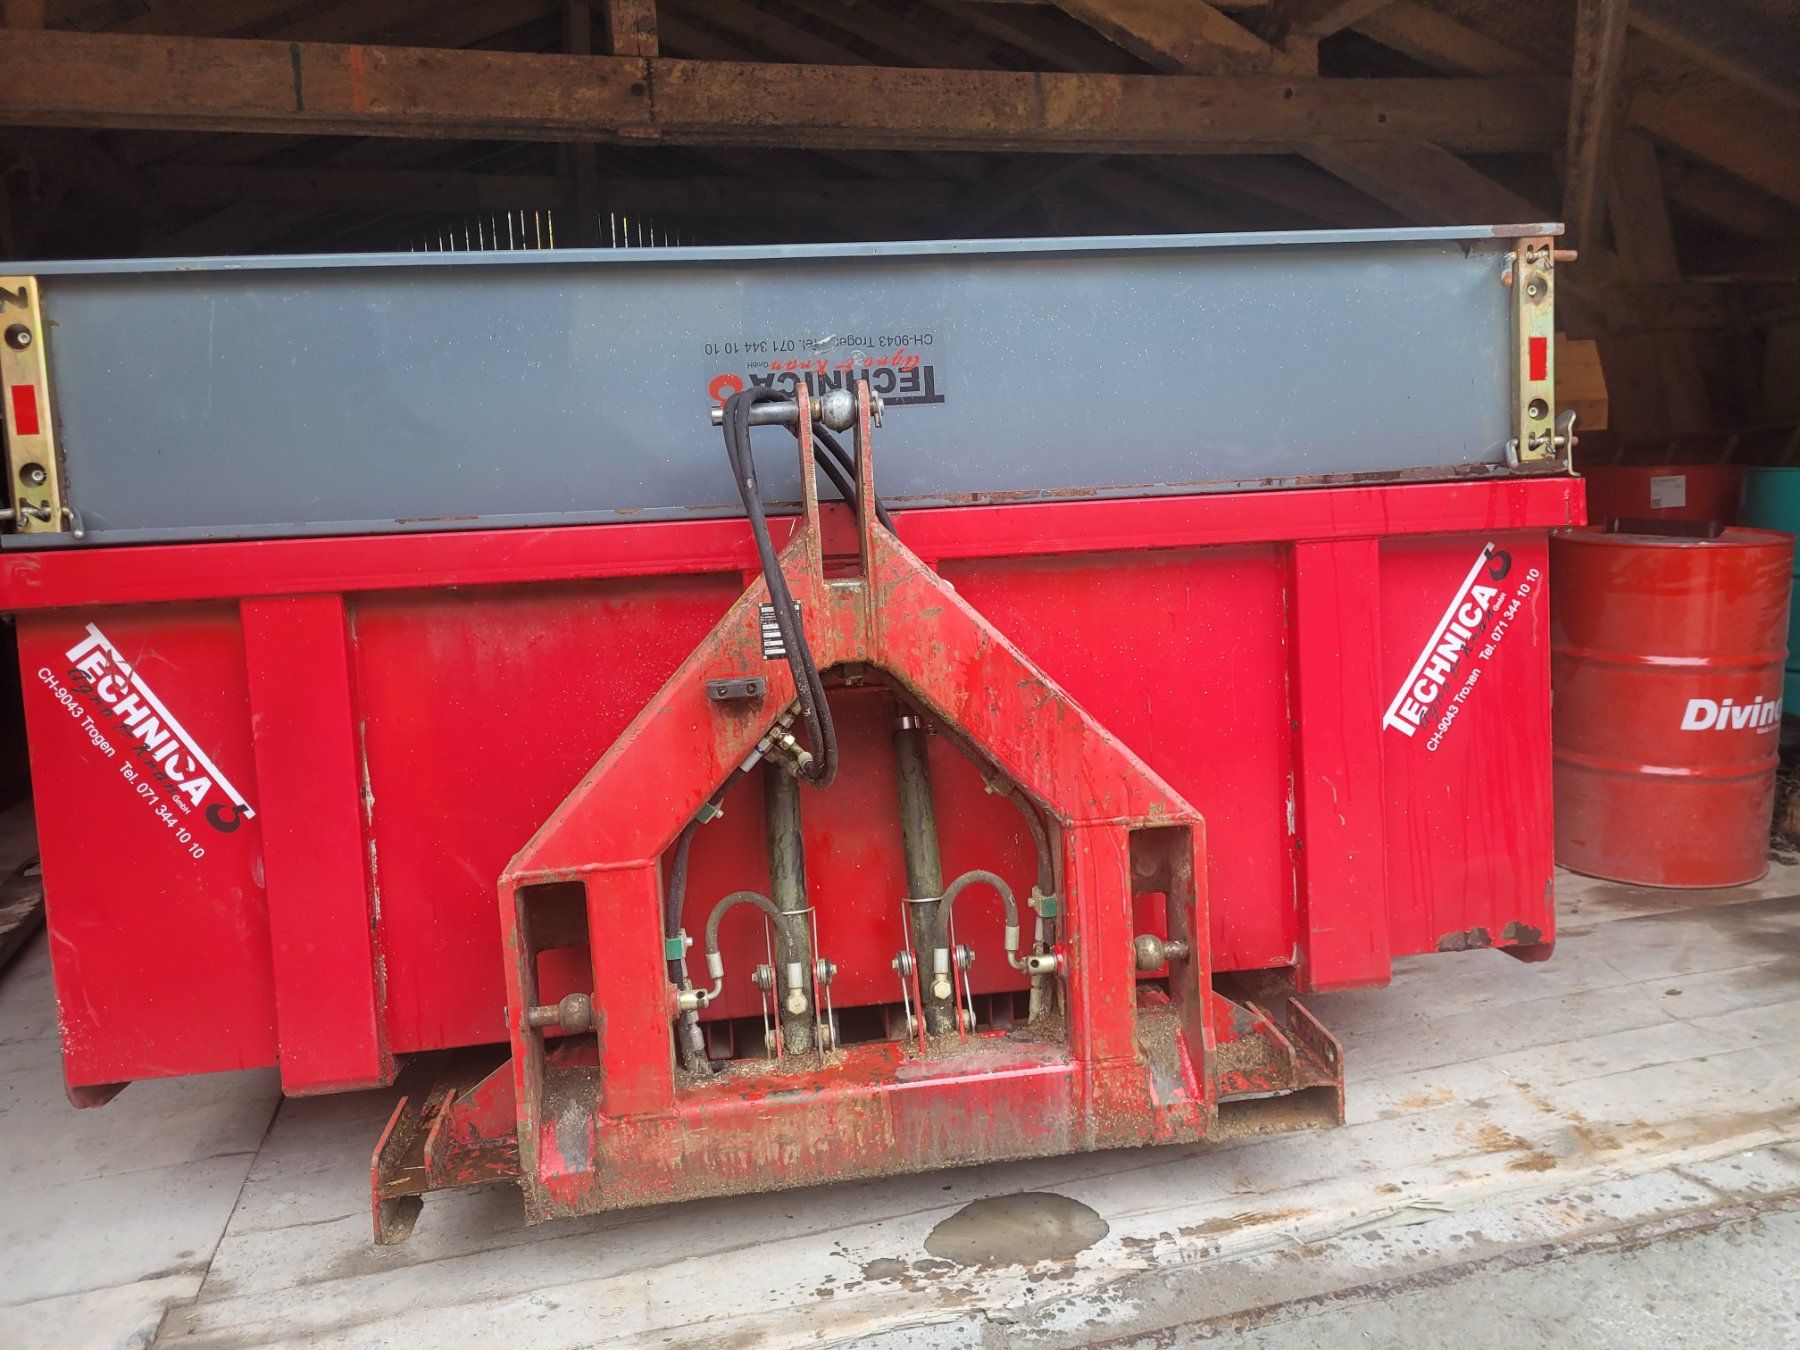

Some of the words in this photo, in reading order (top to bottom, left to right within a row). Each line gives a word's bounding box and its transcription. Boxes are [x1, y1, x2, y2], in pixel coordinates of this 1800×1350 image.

[704, 343, 720, 356] 10
[724, 342, 740, 355] 10
[744, 341, 768, 354] 344
[772, 340, 795, 352] 071
[879, 333, 934, 348] CH-9043
[746, 360, 769, 369] GmbH
[769, 357, 830, 376] Kran
[862, 347, 921, 372] Agro
[1492, 592, 1507, 613] GmbH
[1382, 541, 1496, 738] TECHNICA
[1426, 703, 1459, 752] CH-9043
[1478, 643, 1497, 660] Tel.
[1490, 620, 1509, 642] 071
[1503, 598, 1522, 621] 344
[1516, 583, 1531, 598] 10
[1525, 568, 1540, 583] 10
[65, 621, 256, 821] TECHNICA
[37, 667, 85, 719] CH-9043
[80, 715, 117, 758] Trogen
[118, 760, 140, 785] Tel.
[136, 782, 160, 806] 071
[155, 804, 179, 829] 344
[175, 827, 192, 844] 10
[188, 843, 206, 860] 10
[172, 794, 192, 816] GmbH
